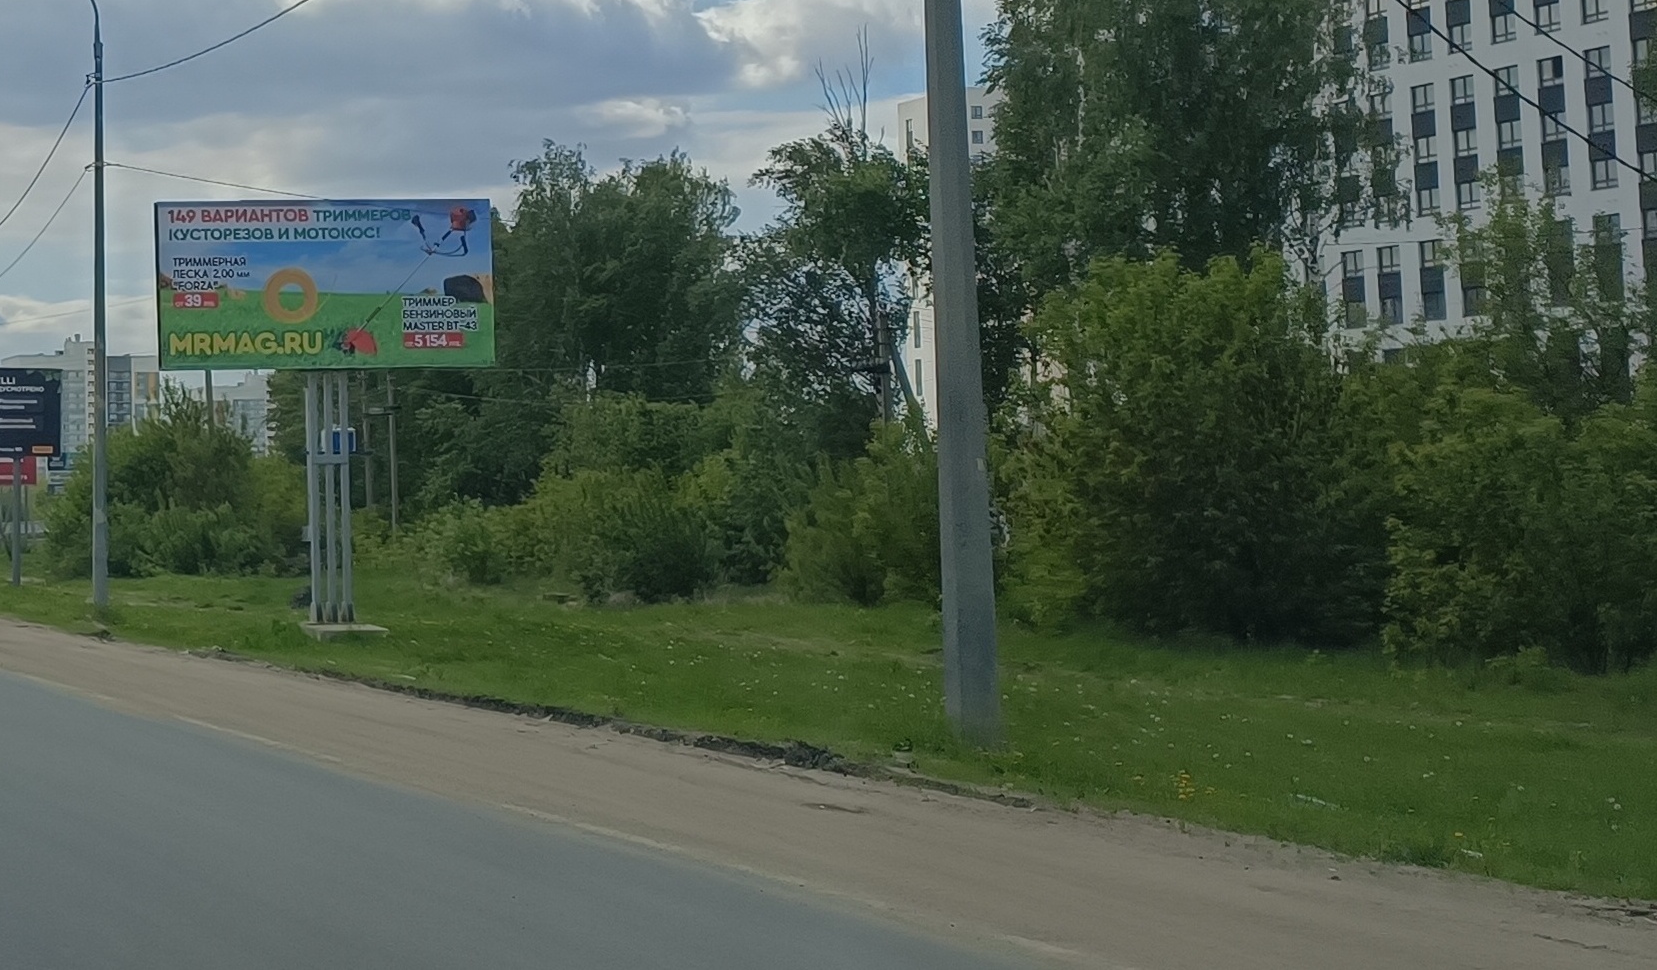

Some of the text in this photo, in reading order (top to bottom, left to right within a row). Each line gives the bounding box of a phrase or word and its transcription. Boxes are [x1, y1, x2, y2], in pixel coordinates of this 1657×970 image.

[167, 208, 411, 224] 149 ВАРИАНТОВ ТРИММЕРОВ
[168, 226, 381, 241] КУСТОРЕЗОВ И МОТОКОС!
[173, 257, 247, 267] ТРИММЕРНАЯ
[172, 269, 209, 279] ЛЕСКА
[185, 295, 201, 307] 39
[402, 297, 455, 306] ТРИММЕР
[402, 306, 477, 319] БЕНЗИНОВЫЙ
[403, 321, 444, 330] MASTER
[169, 331, 323, 356] MRMAG.RU
